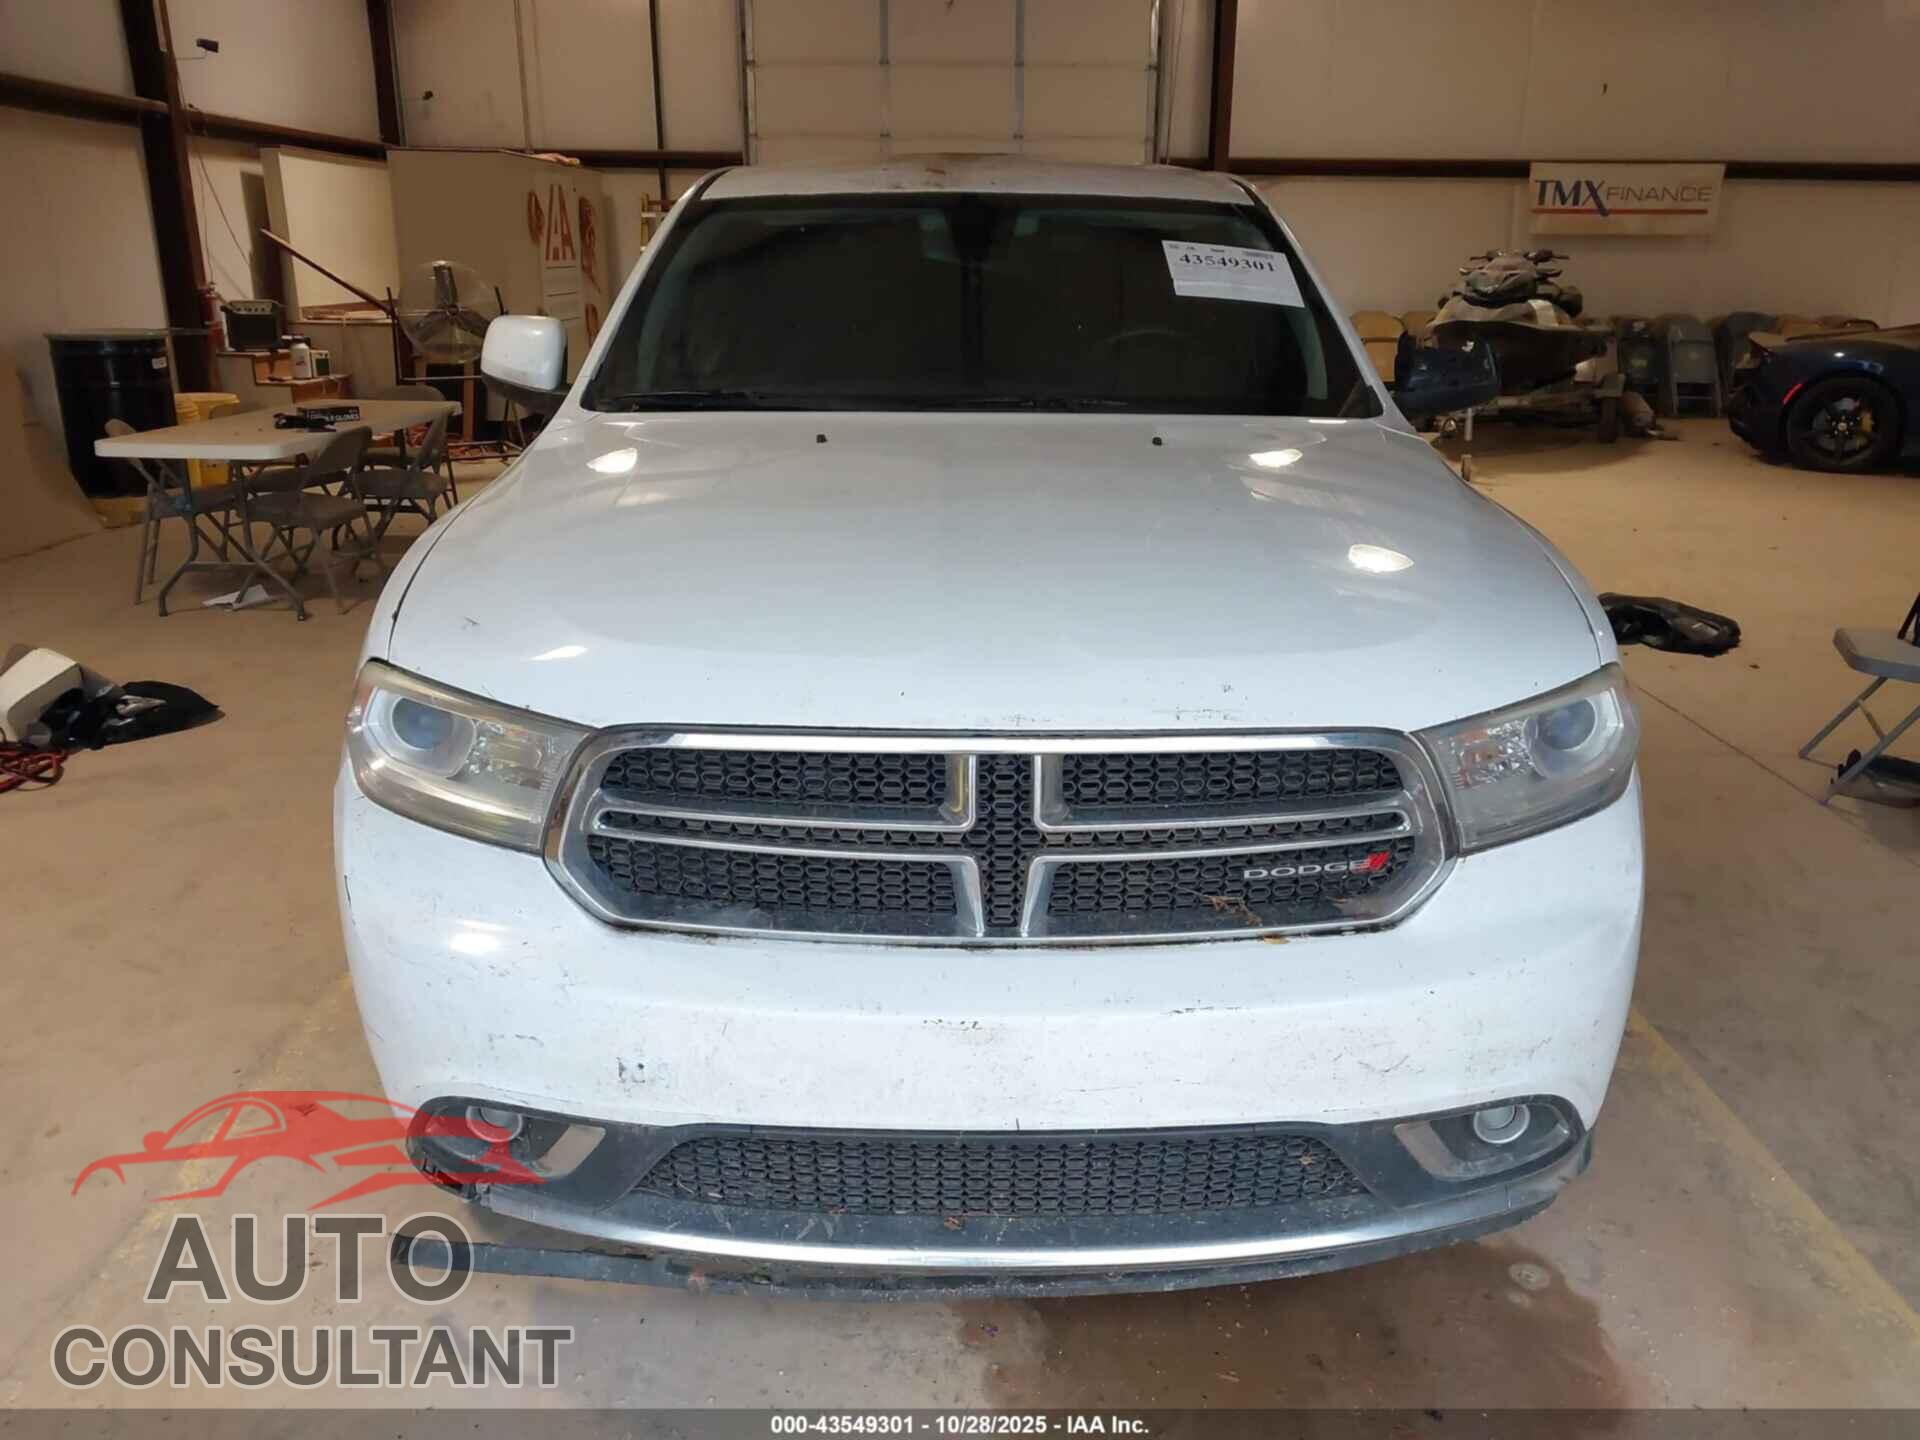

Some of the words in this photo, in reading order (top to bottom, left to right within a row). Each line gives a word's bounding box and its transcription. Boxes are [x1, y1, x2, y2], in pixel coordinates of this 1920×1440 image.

[1535, 180, 1609, 217] TMX
[1606, 185, 1712, 202] FINANCE
[1179, 253, 1276, 272] 43549301
[1243, 858, 1371, 879] DODGE
